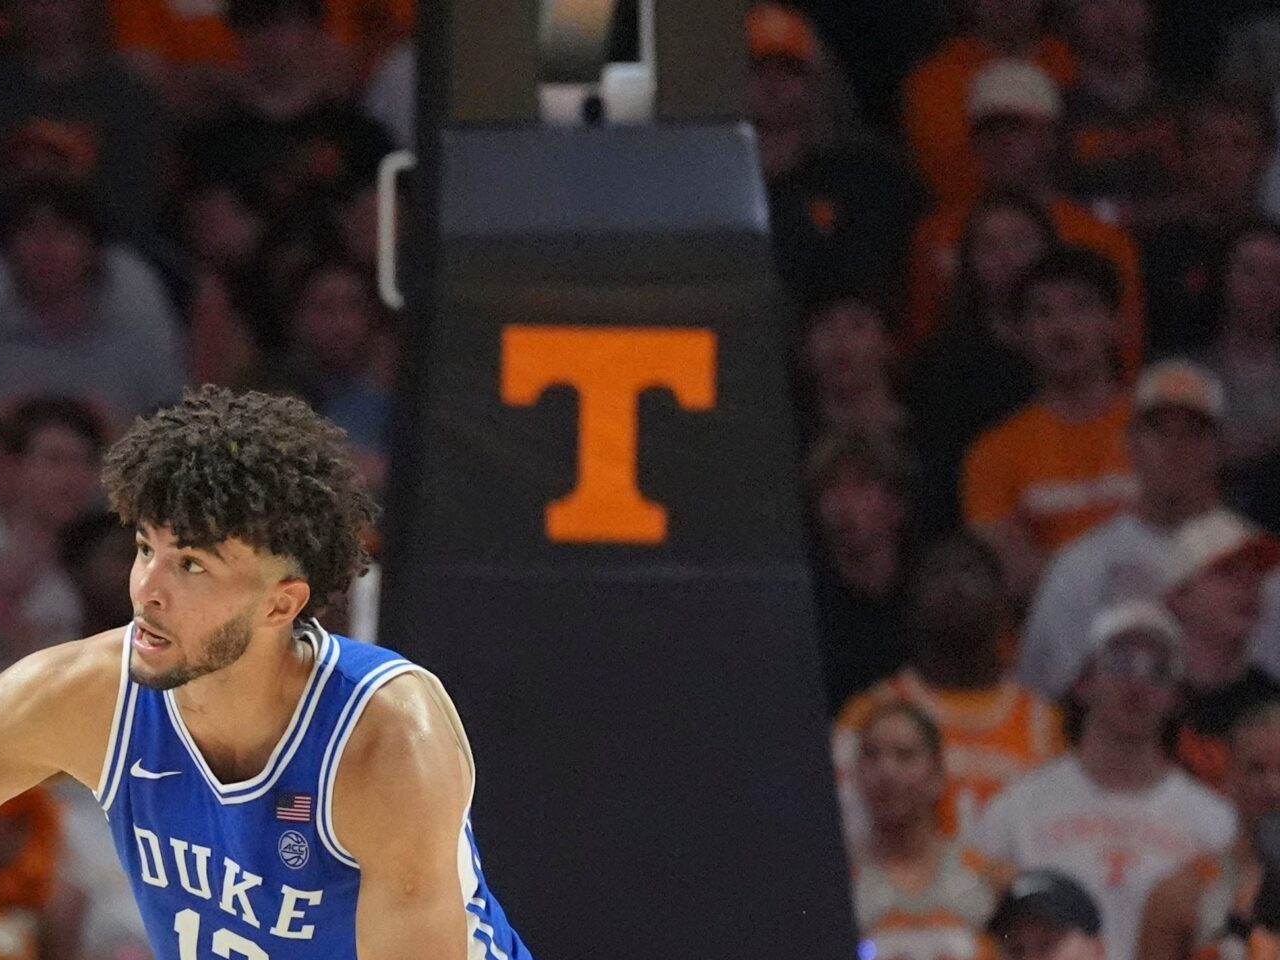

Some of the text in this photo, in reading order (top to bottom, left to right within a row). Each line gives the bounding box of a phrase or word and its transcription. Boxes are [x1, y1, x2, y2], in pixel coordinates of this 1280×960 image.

[500, 325, 717, 544] T
[133, 822, 323, 940] DUKE
[283, 843, 306, 855] ACC
